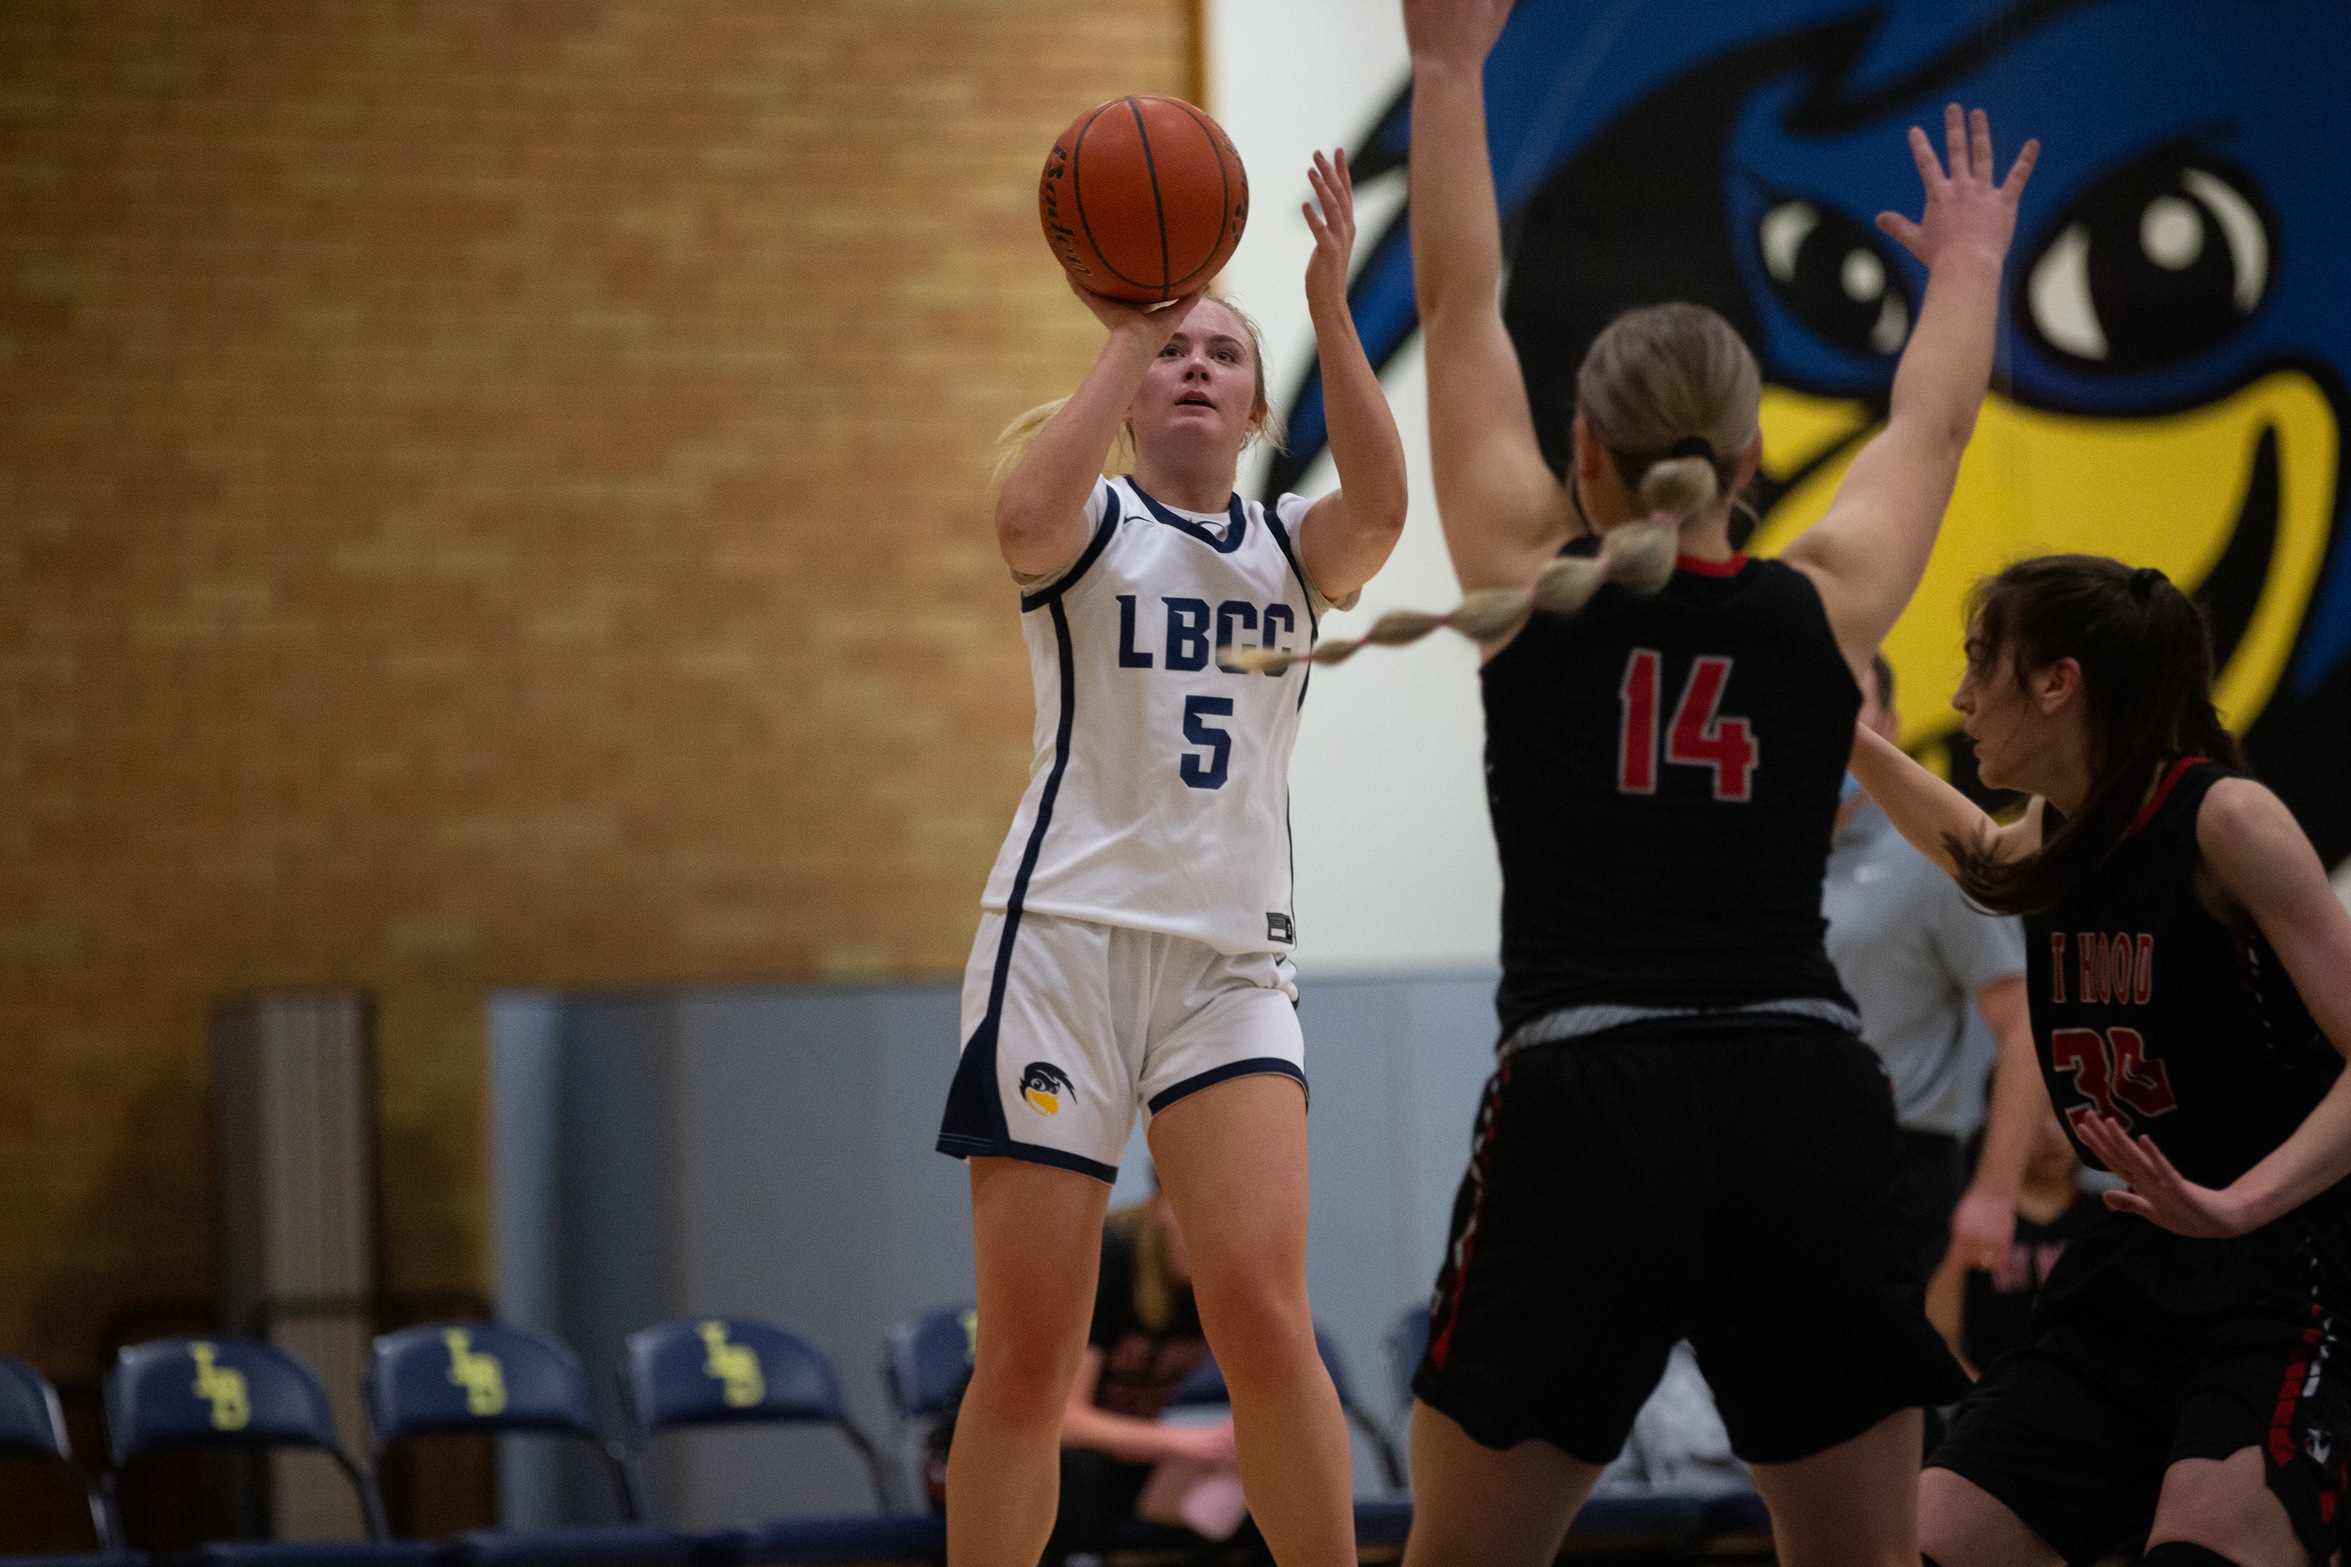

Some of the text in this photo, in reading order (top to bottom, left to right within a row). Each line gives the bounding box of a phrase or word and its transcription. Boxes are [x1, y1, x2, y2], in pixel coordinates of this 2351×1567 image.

[1116, 595, 1294, 677] LBCC
[1180, 695, 1234, 790] 5
[1617, 647, 1760, 803] 14
